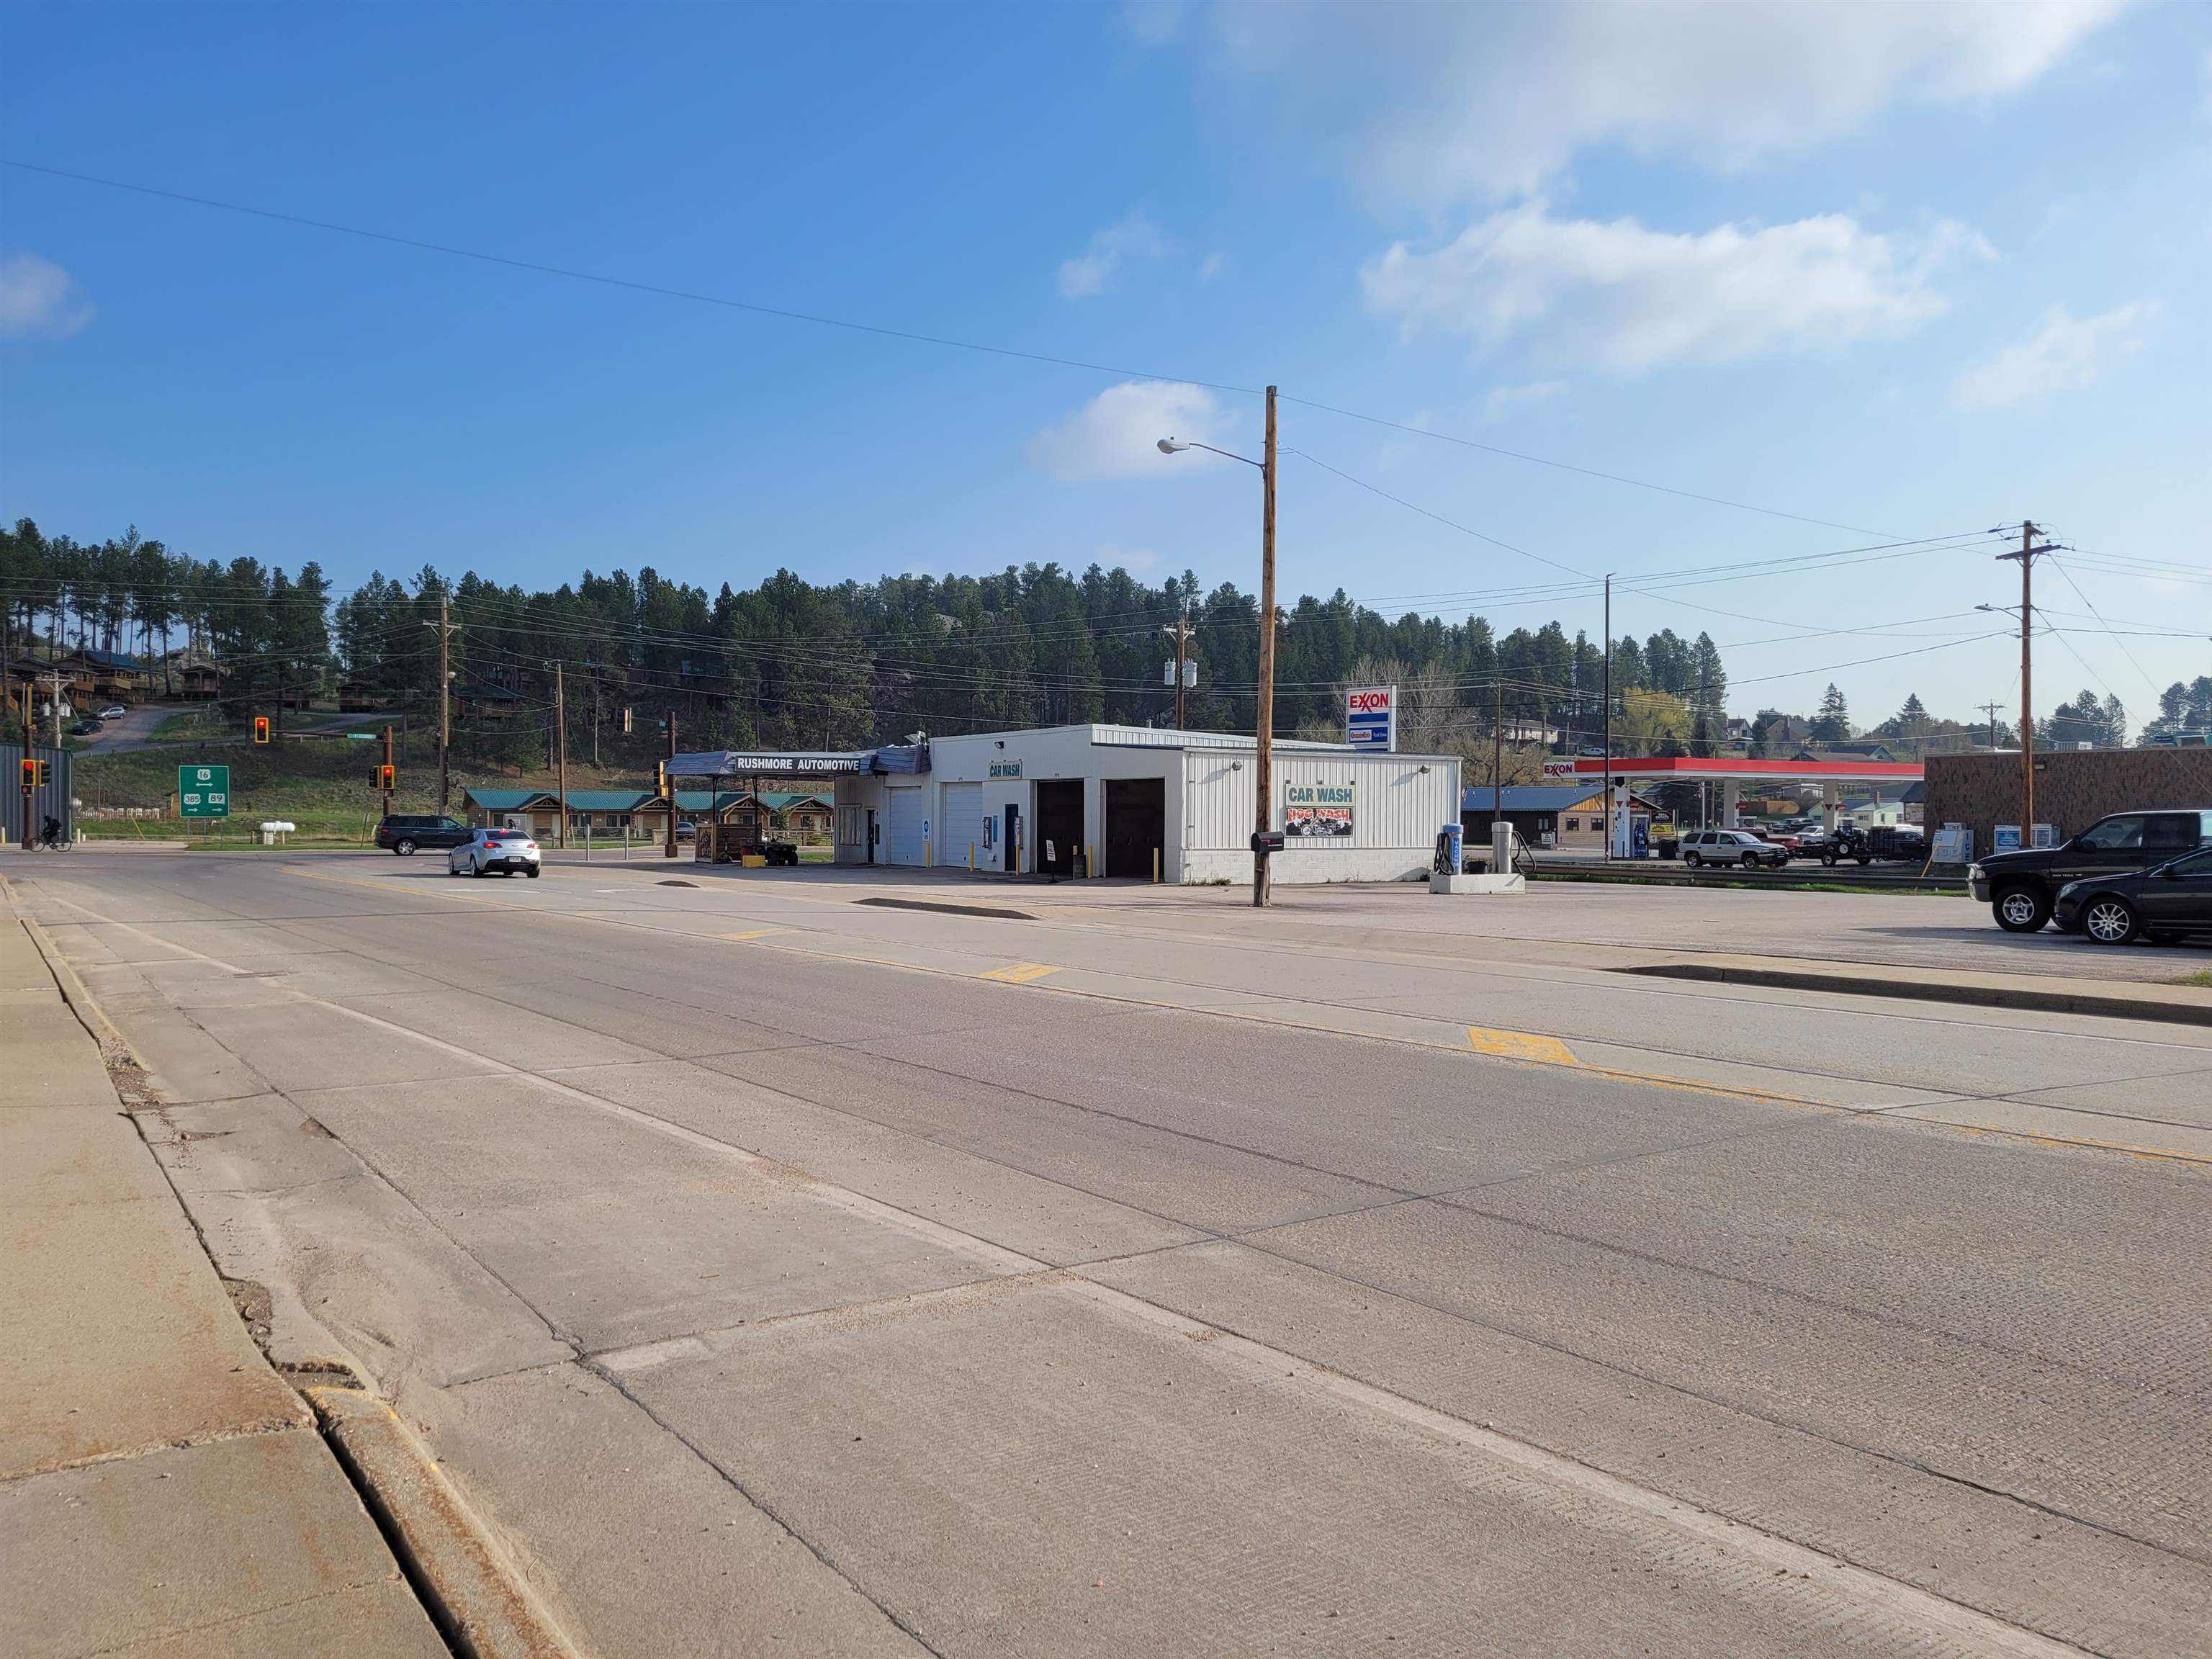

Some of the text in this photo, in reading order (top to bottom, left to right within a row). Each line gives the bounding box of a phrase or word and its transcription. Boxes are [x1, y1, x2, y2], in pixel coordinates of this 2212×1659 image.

[1350, 692, 1389, 713] EXXON
[737, 757, 859, 771] RUSHMORE AUTOMOTIVE
[990, 764, 1020, 778] CAR WASH
[1544, 763, 1573, 777] EXXON
[1289, 788, 1352, 803] CAR WASH
[1287, 809, 1350, 822] HOG WASH
